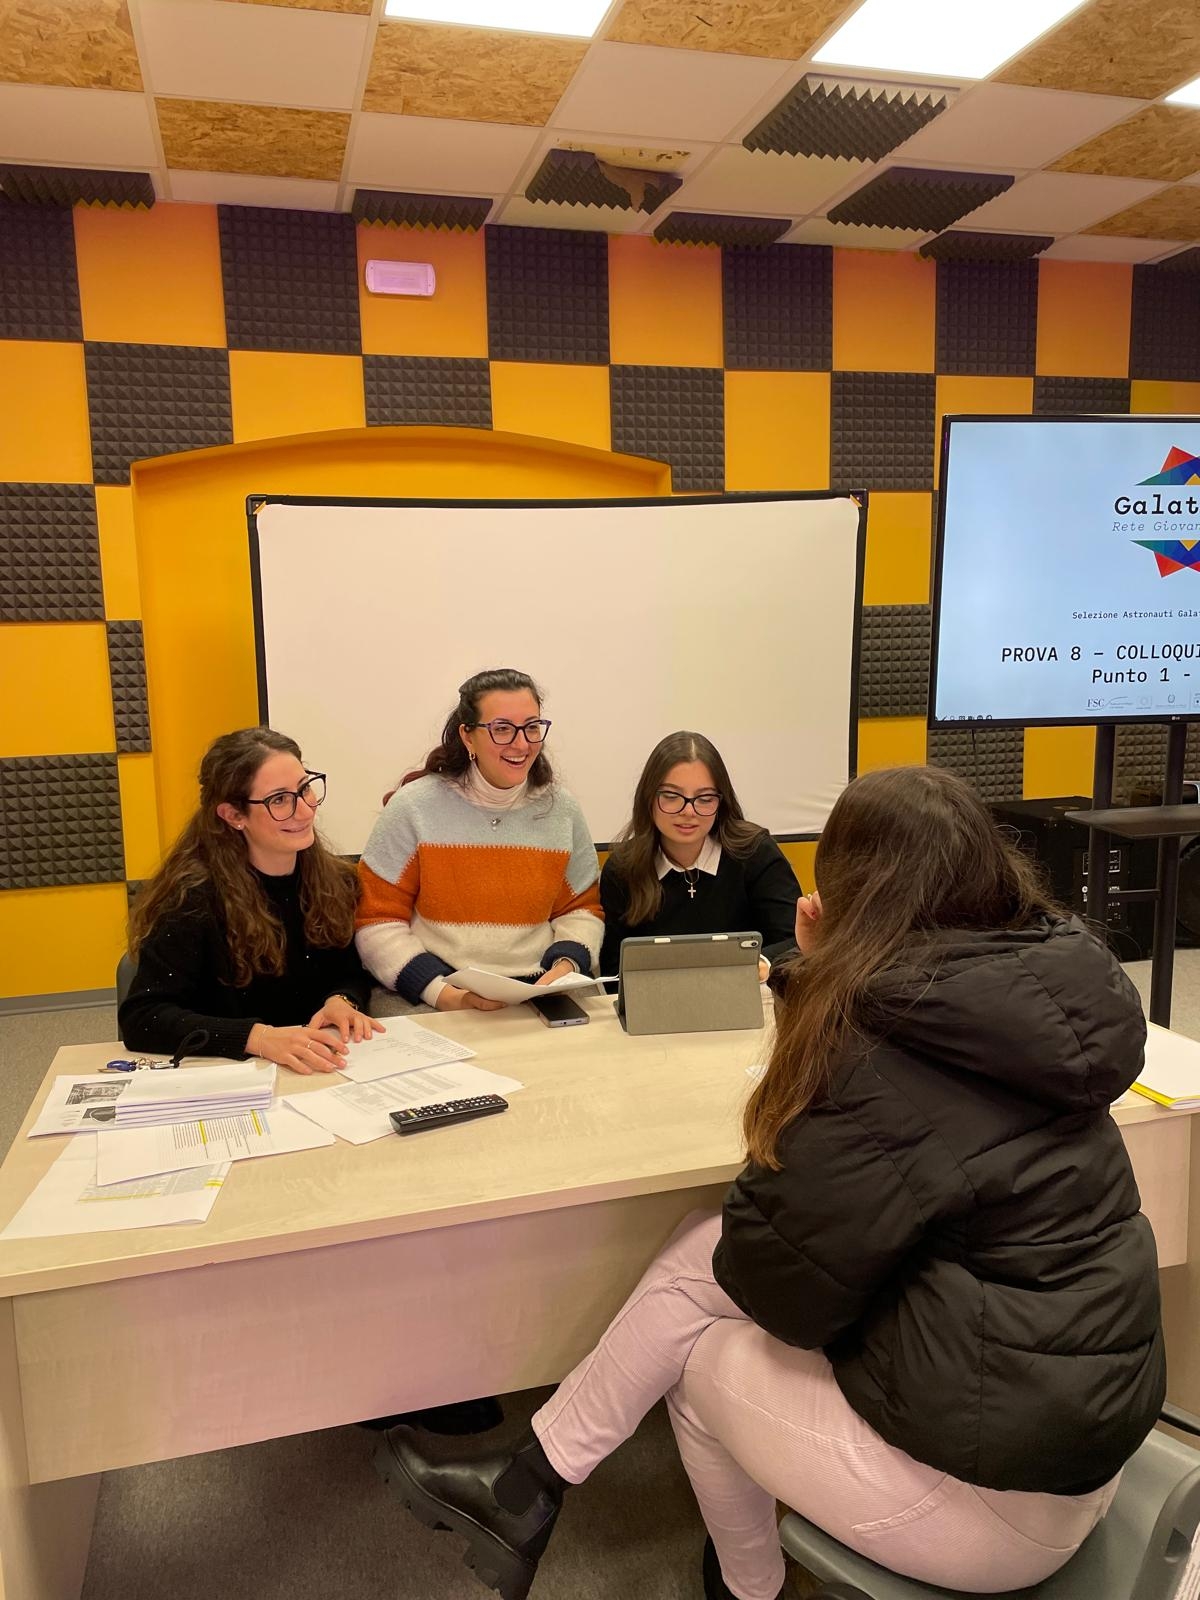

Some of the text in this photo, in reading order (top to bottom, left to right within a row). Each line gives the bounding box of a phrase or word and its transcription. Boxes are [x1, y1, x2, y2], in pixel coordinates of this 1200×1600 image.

[1112, 520, 1145, 532] Rete
[1072, 611, 1118, 620] Selezione
[1122, 611, 1173, 619] Astronauti
[1001, 646, 1059, 662] PROVA
[1070, 646, 1081, 661] 8
[1092, 668, 1148, 684] Punto
[1159, 667, 1170, 682] 1
